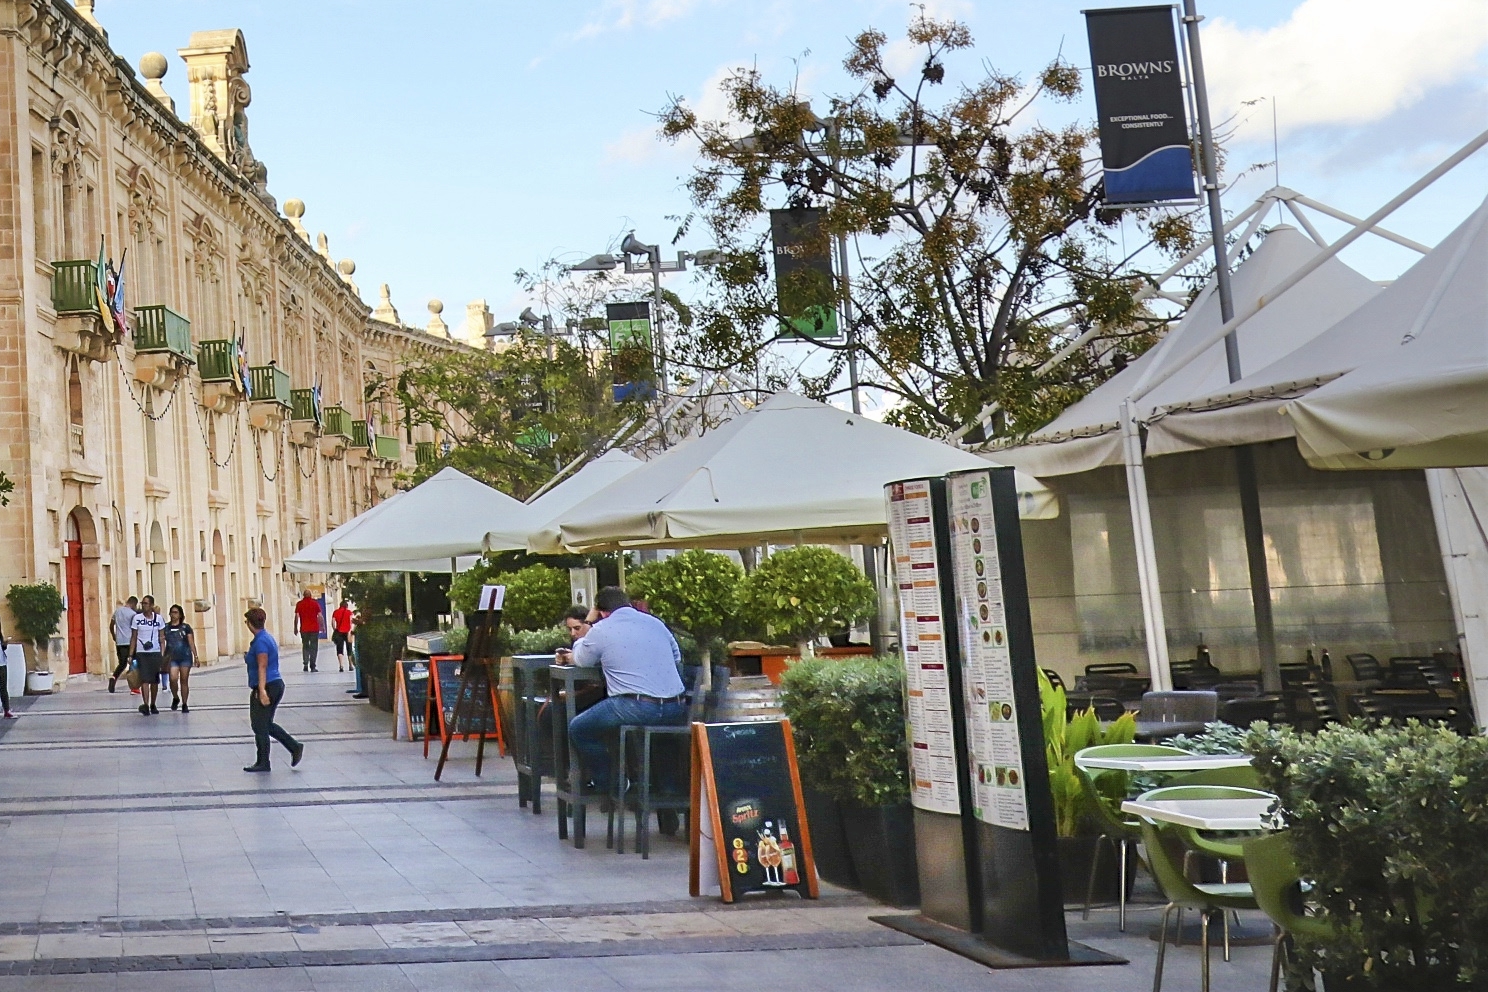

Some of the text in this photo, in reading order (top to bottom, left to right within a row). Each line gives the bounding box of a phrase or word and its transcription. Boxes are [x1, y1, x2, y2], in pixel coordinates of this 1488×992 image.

[1097, 60, 1172, 77] BROWNS
[1109, 114, 1150, 123] EXCEPTIONAL
[1121, 121, 1164, 129] CONSISTENTLY
[737, 849, 745, 861] 2
